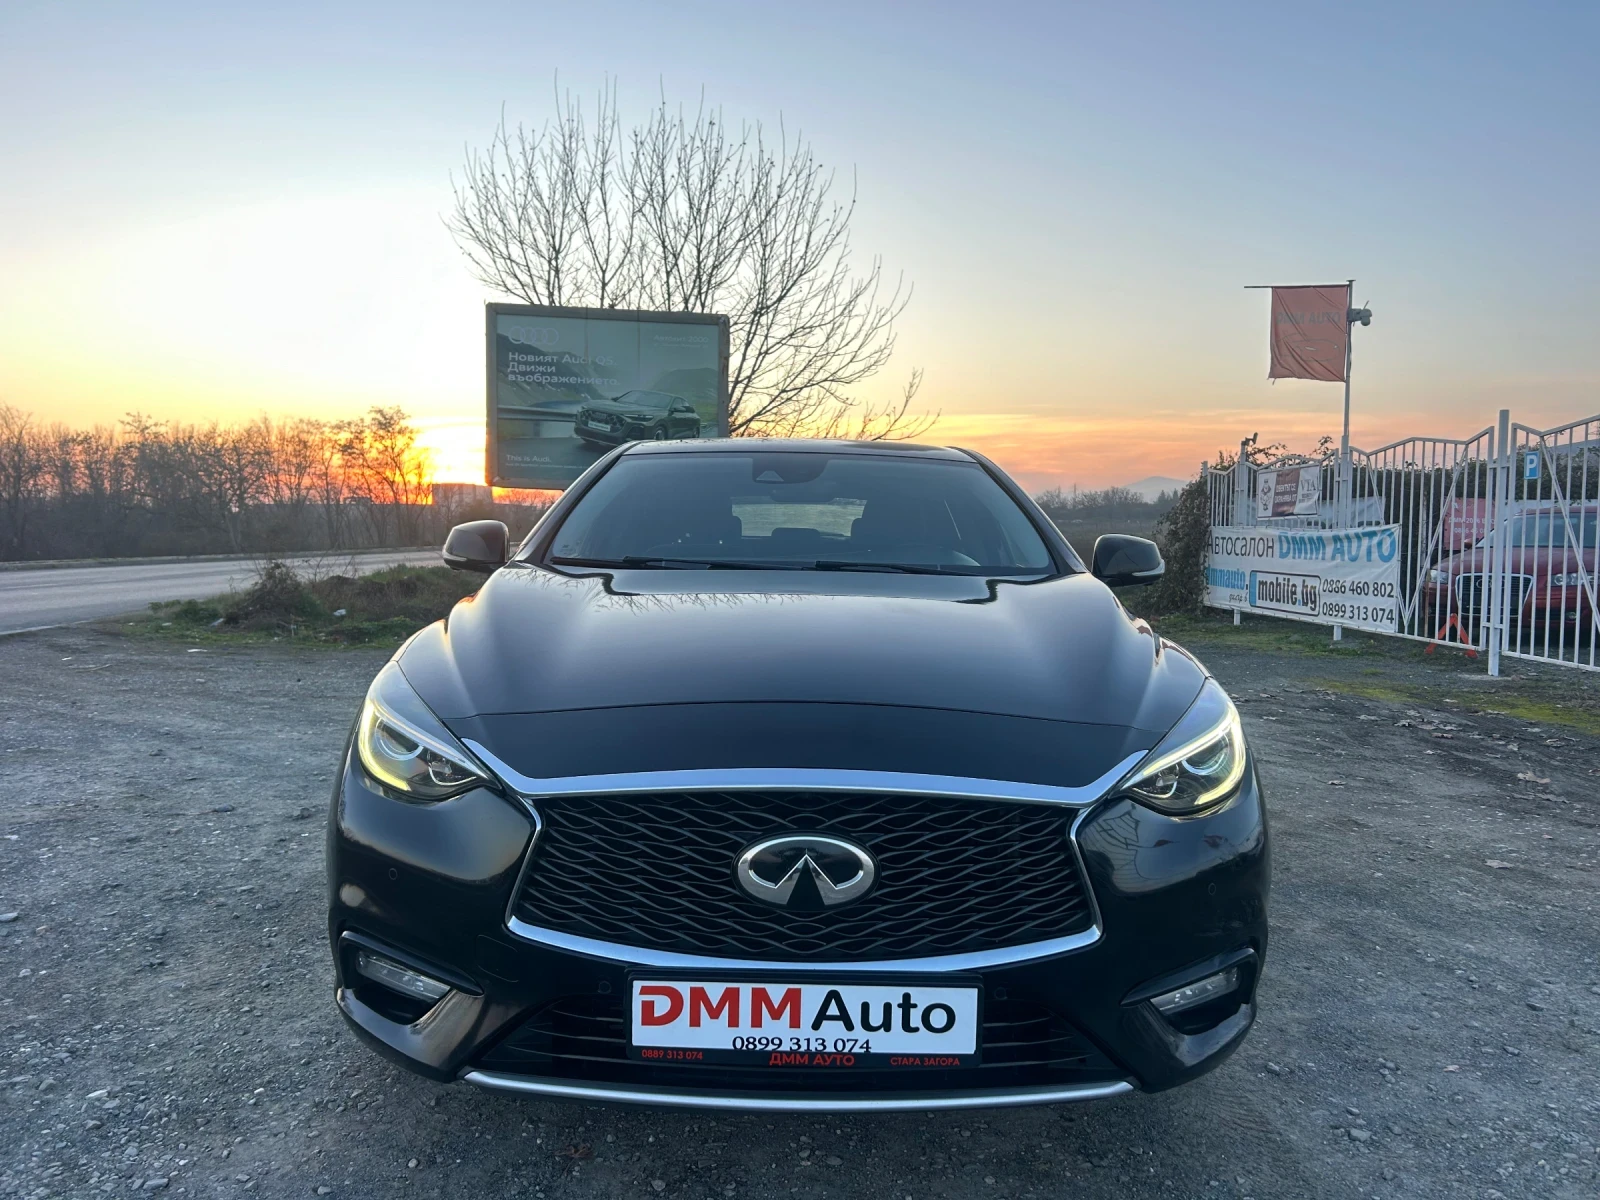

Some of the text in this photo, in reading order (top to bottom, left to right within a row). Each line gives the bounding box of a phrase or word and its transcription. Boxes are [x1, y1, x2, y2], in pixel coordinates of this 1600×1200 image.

[508, 351, 559, 363] Новият
[507, 361, 556, 373] Движи
[507, 373, 621, 386] въображението.
[523, 454, 531, 462] is
[1526, 454, 1538, 477] P
[1207, 528, 1397, 563] Автосалон DMM AUTO
[1258, 576, 1318, 612] mobile.bg
[1322, 578, 1395, 598] 0886 460 802
[1322, 601, 1395, 624] 0899 313 074
[638, 985, 957, 1034] DMM Auto
[732, 1036, 872, 1053] 0899 313 074
[665, 1050, 684, 1060] 313
[685, 1051, 703, 1060] 074
[769, 1052, 855, 1067] ДММ АУТО
[890, 1057, 960, 1067] СТАРА ЗАГОРА
